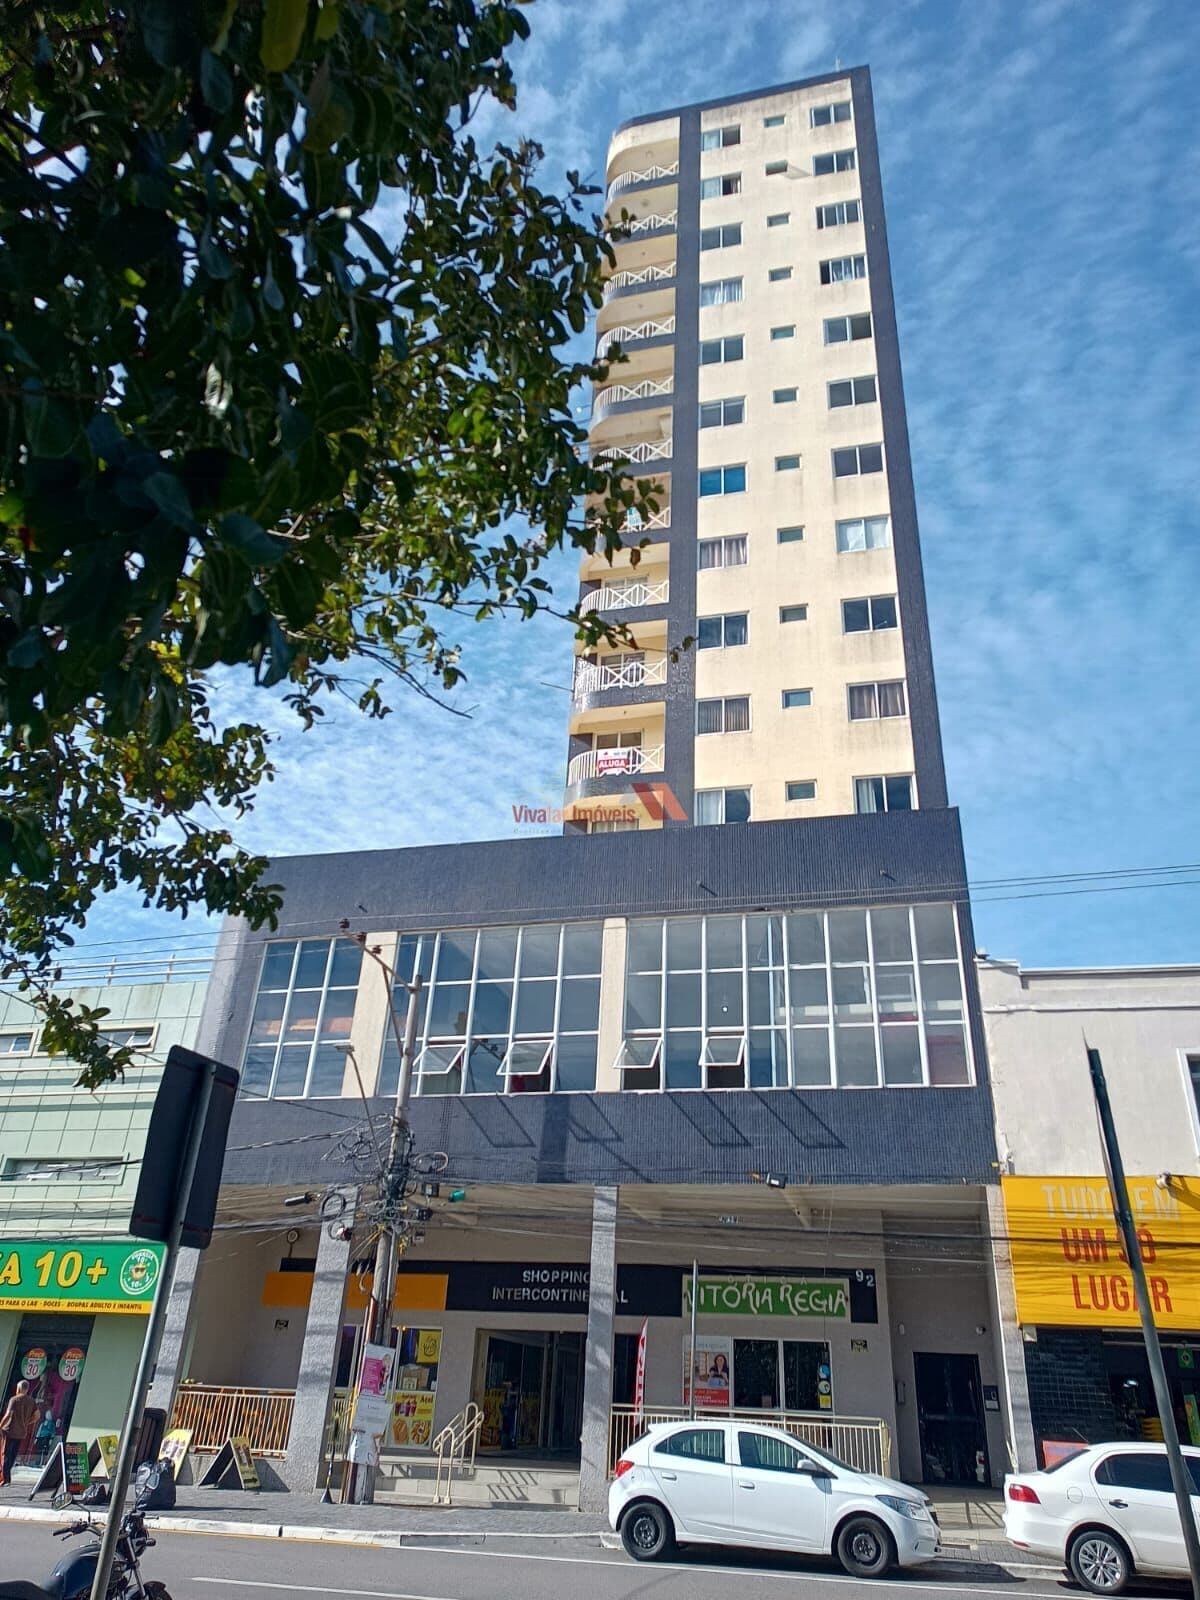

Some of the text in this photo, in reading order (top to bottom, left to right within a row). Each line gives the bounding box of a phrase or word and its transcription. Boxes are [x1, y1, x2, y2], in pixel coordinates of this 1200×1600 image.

[599, 760, 626, 769] ALUGA
[1133, 1186, 1180, 1221] EM
[1060, 1227, 1109, 1263] UM
[27, 1363, 39, 1376] 30
[64, 1364, 77, 1377] 30
